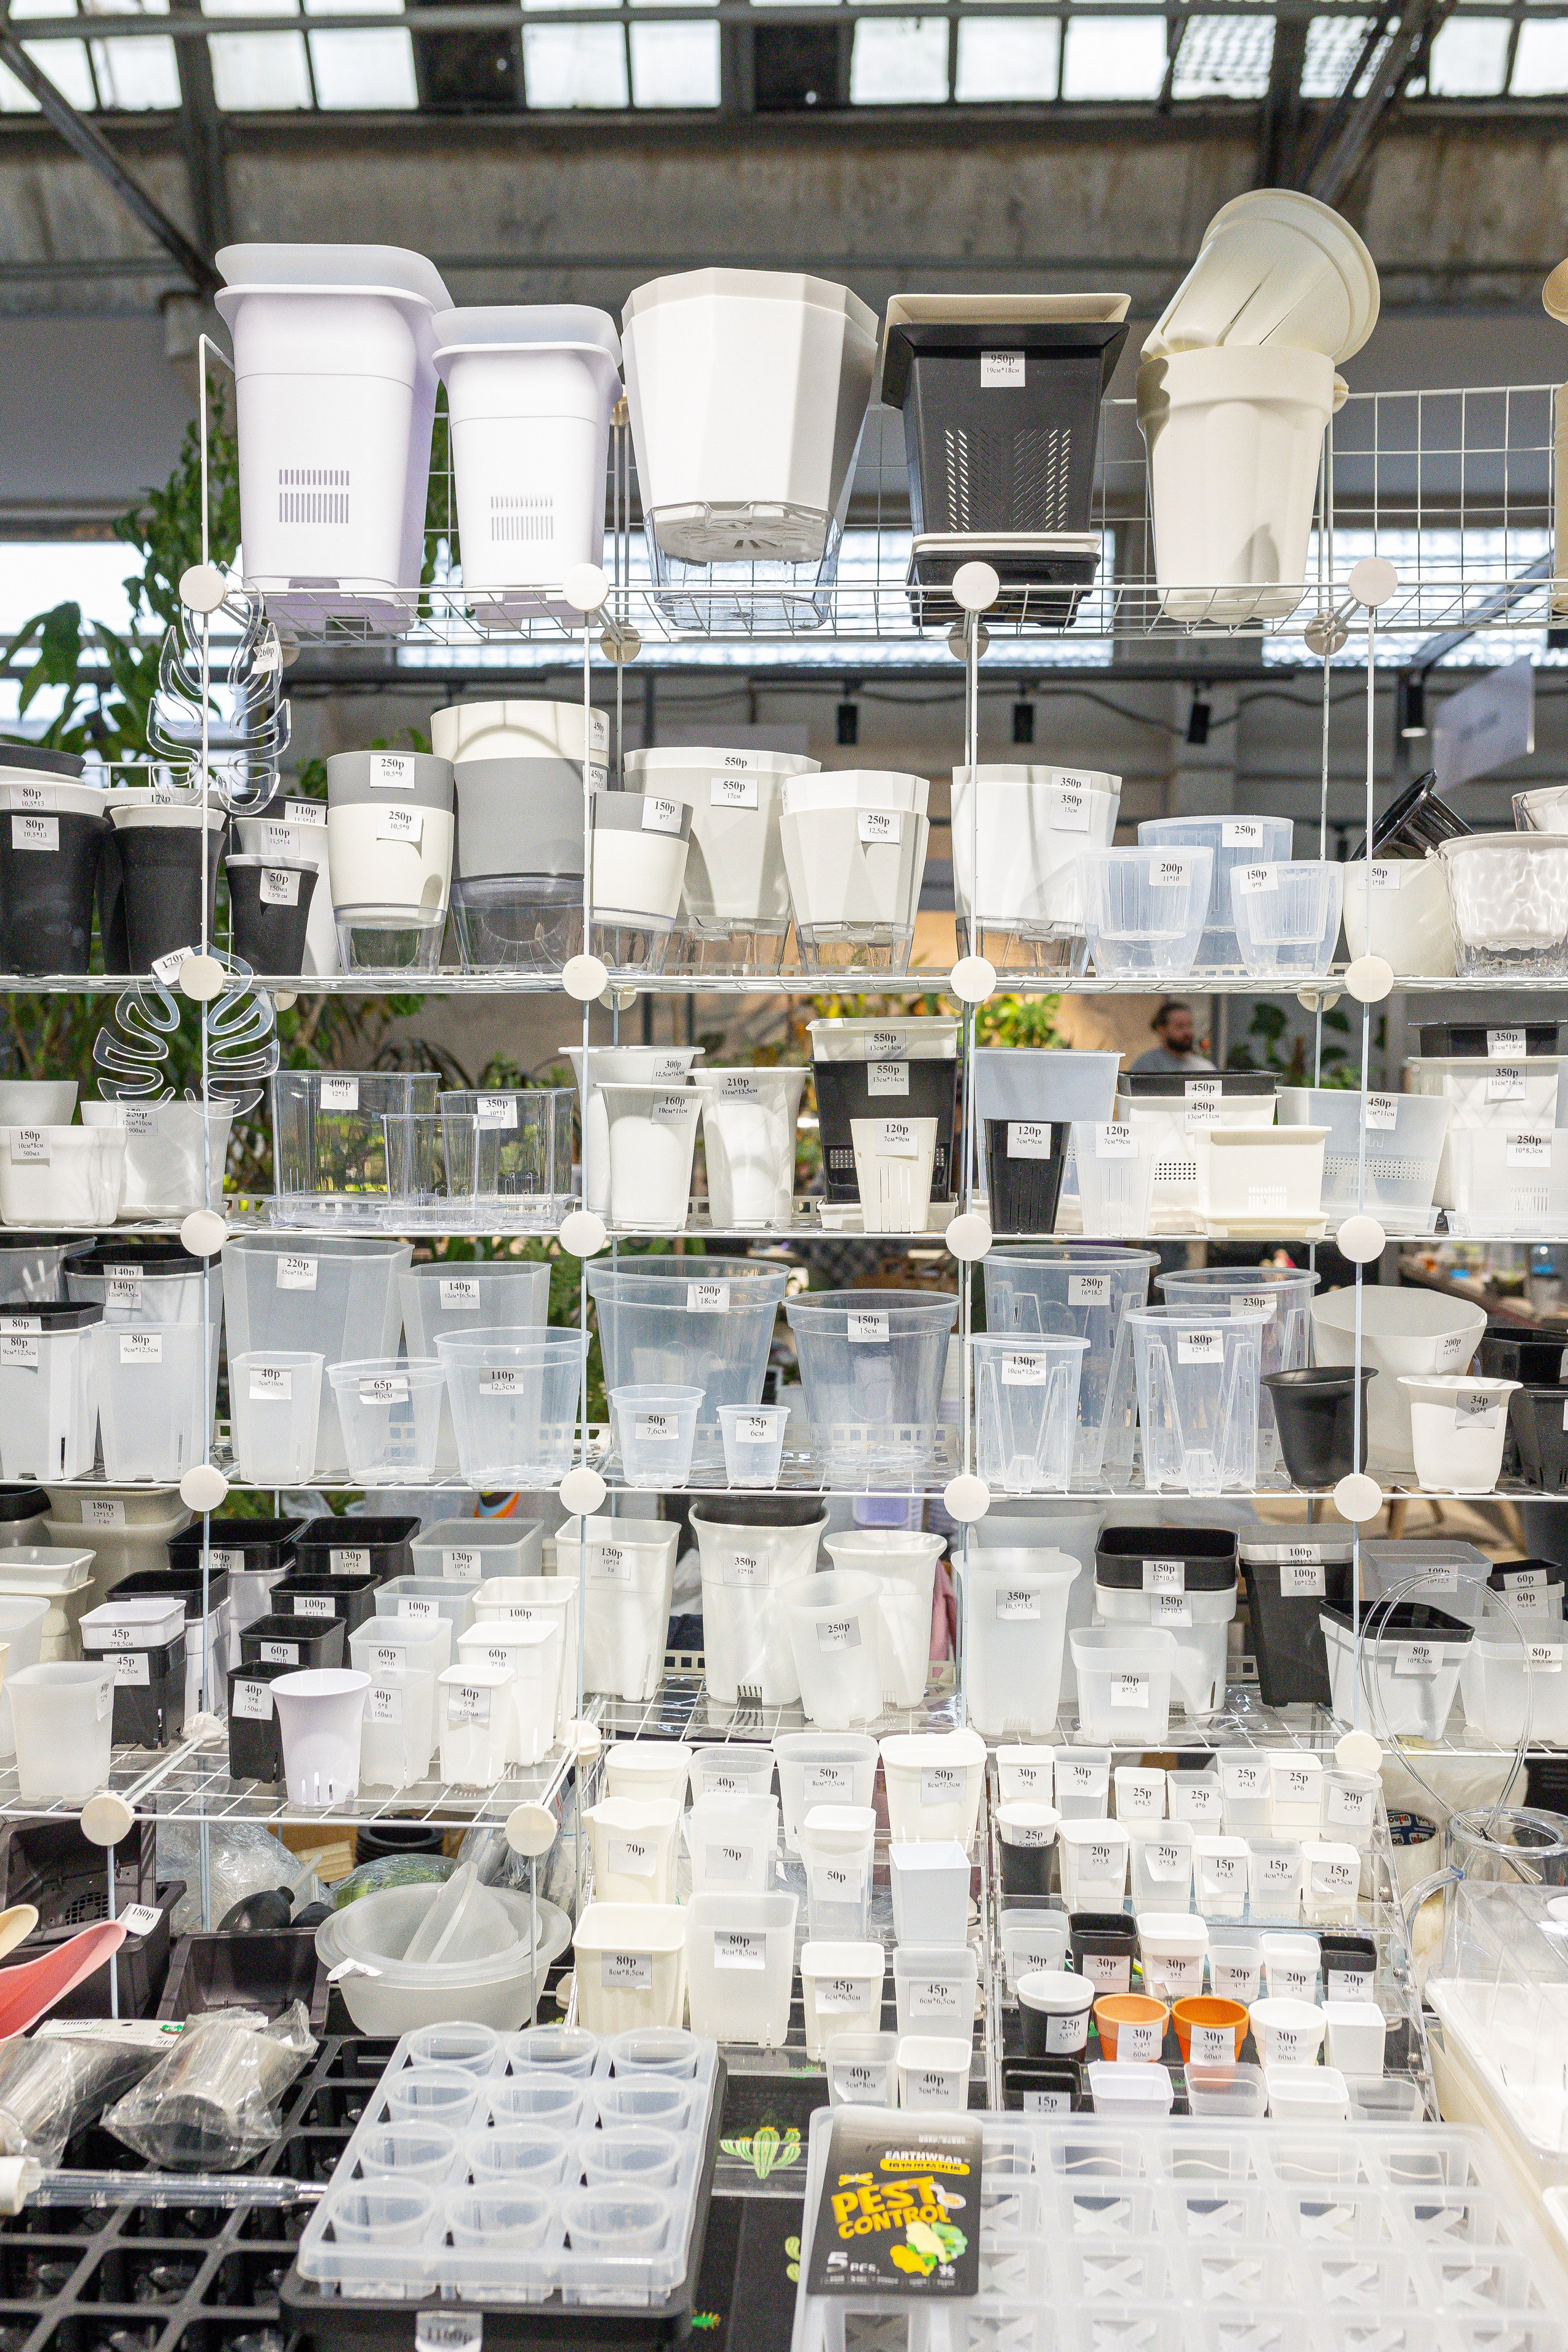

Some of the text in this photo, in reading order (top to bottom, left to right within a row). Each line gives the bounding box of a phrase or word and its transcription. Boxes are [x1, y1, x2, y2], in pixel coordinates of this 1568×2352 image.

[991, 355, 1014, 365] 950р
[259, 647, 274, 657] 260р
[381, 758, 404, 770] 250р
[725, 756, 747, 768] 550р
[723, 780, 745, 792] 550р
[22, 788, 41, 799] 80р
[1061, 794, 1082, 806] 350р
[295, 805, 316, 817] 110р
[655, 801, 675, 814] 150р
[388, 810, 412, 824] 250р
[867, 815, 889, 827] 250р
[25, 820, 43, 831] 80р
[1235, 825, 1256, 835] 250р
[270, 827, 290, 838] 110р
[1160, 863, 1182, 874] 200р
[270, 873, 288, 885] 50р
[1247, 870, 1267, 880] 150р
[873, 1033, 896, 1043] 550р
[1494, 1031, 1518, 1042] 350р
[665, 1060, 681, 1070] 300р
[876, 1065, 899, 1075] 550р
[1495, 1068, 1518, 1078] 350р
[329, 1079, 351, 1090] 400р
[727, 1077, 749, 1087] 210р
[486, 1098, 508, 1109] 350р
[665, 1096, 685, 1107] 160р
[1191, 1102, 1214, 1112] 450р
[1368, 1098, 1391, 1109] 450р
[886, 1124, 908, 1135] 120р
[1019, 1126, 1041, 1137] 120р
[1106, 1126, 1129, 1137] 120р
[20, 1131, 40, 1141] 150р
[1517, 1135, 1542, 1146] 250р
[287, 1259, 309, 1271] 220р
[113, 1281, 134, 1291] 140р
[450, 1282, 470, 1292] 140р
[1081, 1278, 1102, 1288] 280р
[698, 1285, 720, 1295] 200р
[1243, 1297, 1265, 1307] 230р
[12, 1319, 30, 1329] 80р
[858, 1315, 880, 1325] 150р
[10, 1337, 28, 1348] 80р
[132, 1335, 150, 1346] 80р
[1189, 1335, 1212, 1345] 180р
[1444, 1338, 1461, 1349] 200р
[1013, 1356, 1035, 1367] 130р
[261, 1368, 280, 1380] 40р
[491, 1371, 514, 1381] 110р
[374, 1380, 391, 1392] 65р
[1470, 1395, 1488, 1406] 34р
[647, 1415, 665, 1426] 50р
[749, 1417, 766, 1428] 35р
[92, 1502, 113, 1511] 180р
[213, 1552, 230, 1562] 90р
[341, 1551, 361, 1561] 130р
[451, 1552, 472, 1562] 130р
[602, 1548, 623, 1559] 130р
[1290, 1548, 1311, 1558] 100р
[734, 1557, 756, 1568] 350р
[1153, 1564, 1174, 1574] 150р
[1294, 1569, 1316, 1579] 100р
[1007, 1591, 1030, 1602] 350р
[1161, 1596, 1182, 1607] 150р
[1517, 1593, 1535, 1602] 60р
[304, 1599, 325, 1610] 100р
[409, 1602, 429, 1613] 100р
[510, 1609, 532, 1619] 100р
[827, 1623, 850, 1633] 250р
[111, 1629, 129, 1640] 45р
[271, 1646, 288, 1657] 60р
[378, 1649, 396, 1660] 60р
[488, 1649, 506, 1660] 60р
[1412, 1646, 1429, 1657] 80р
[117, 1656, 134, 1667] 45р
[1121, 1675, 1139, 1686] 70р
[244, 1684, 262, 1696] 40р
[461, 1688, 478, 1700] 40р
[374, 1691, 391, 1702] 40р
[820, 1768, 837, 1779] 50р
[935, 1770, 953, 1780] 50р
[1018, 1768, 1036, 1779] 30р
[1073, 1766, 1091, 1778] 30р
[1238, 1769, 1256, 1779] 25р
[717, 1777, 734, 1788] 40р
[1290, 1772, 1308, 1784] 25р
[1133, 1787, 1152, 1799] 25р
[1191, 1790, 1209, 1801] 25р
[1344, 1792, 1362, 1804] 20р
[626, 1844, 644, 1855] 70р
[723, 1848, 741, 1860] 70р
[1091, 1846, 1109, 1857] 20р
[1159, 1847, 1177, 1858] 20р
[1216, 1859, 1234, 1871] 15р
[1270, 1860, 1287, 1871] 15р
[827, 1871, 846, 1882] 50р
[1331, 1865, 1348, 1877] 15р
[132, 1907, 153, 1920] 180р
[729, 1935, 750, 1947] 80р
[616, 1956, 636, 1968] 80р
[1096, 1958, 1116, 1970] 30р
[1166, 1959, 1185, 1971] 30р
[1287, 1972, 1306, 1985] 20р
[1344, 1973, 1363, 1986] 20р
[833, 1980, 853, 1992] 45р
[927, 1984, 947, 1996] 45р
[1133, 2029, 1152, 2040] 30р
[1276, 2031, 1297, 2044] 30р
[850, 2067, 870, 2080] 40р
[923, 2073, 943, 2086] 40р
[1038, 2096, 1057, 2108] 15р
[885, 2150, 962, 2165] EARTHWEAR
[831, 2175, 936, 2223] PEST
[838, 2204, 951, 2239] CONTROL
